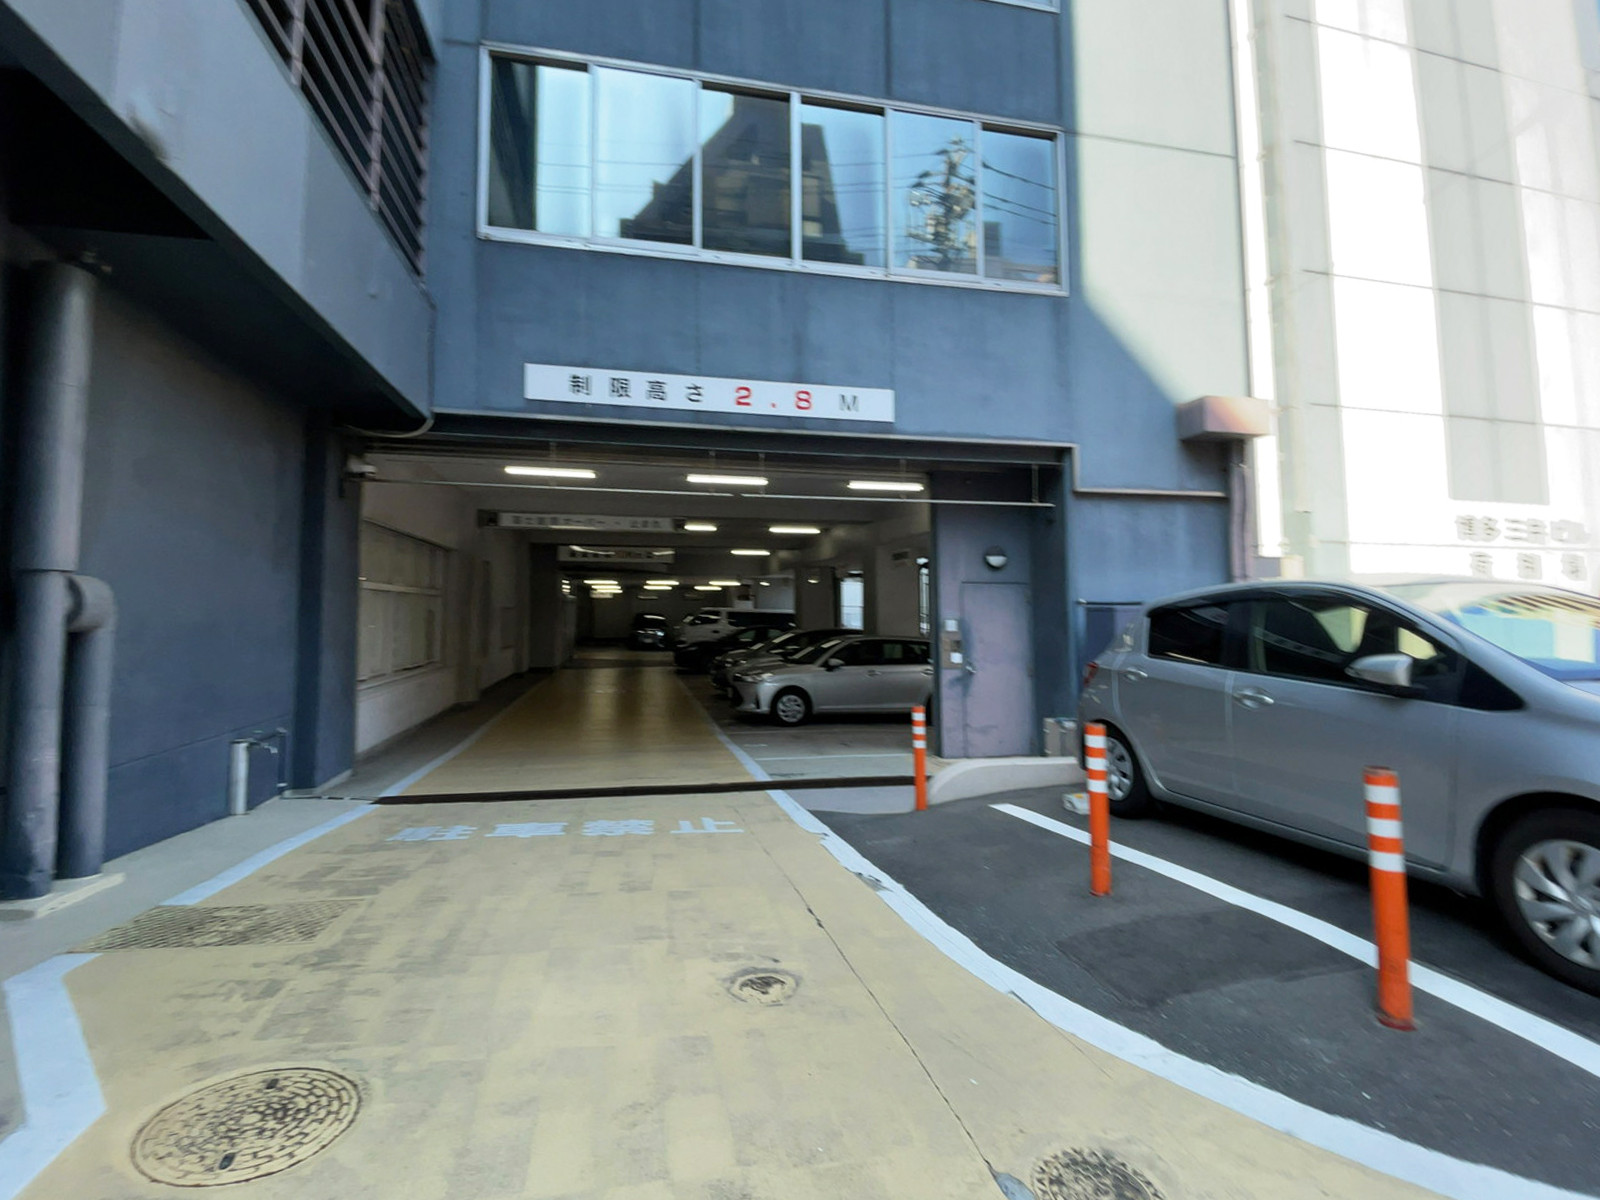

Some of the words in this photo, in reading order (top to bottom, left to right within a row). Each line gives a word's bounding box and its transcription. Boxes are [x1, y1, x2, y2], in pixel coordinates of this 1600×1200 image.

[569, 374, 705, 403] 制限高さ
[735, 386, 812, 411] 2.8
[838, 394, 859, 412] M
[386, 816, 744, 842] 駐車禁止
